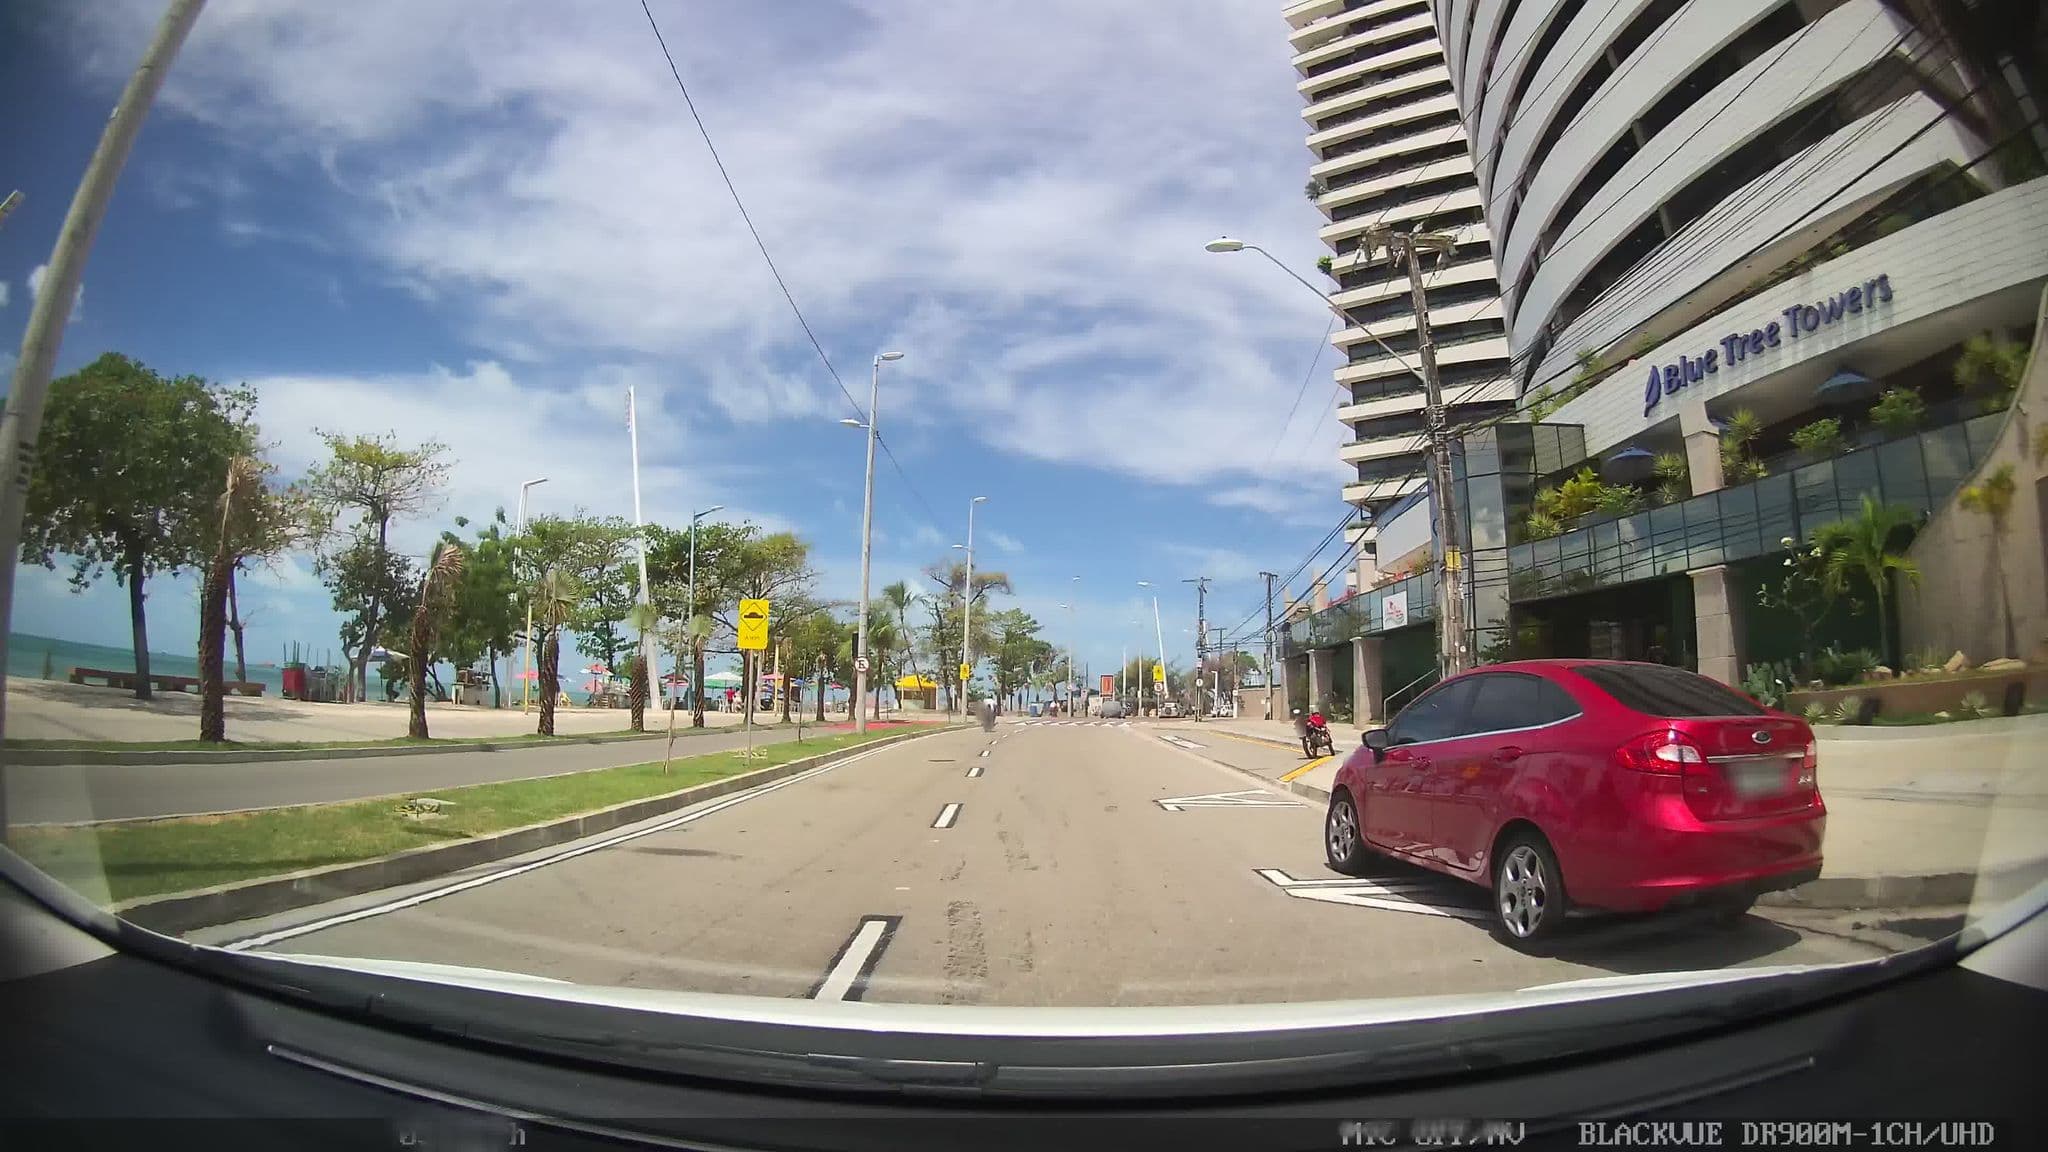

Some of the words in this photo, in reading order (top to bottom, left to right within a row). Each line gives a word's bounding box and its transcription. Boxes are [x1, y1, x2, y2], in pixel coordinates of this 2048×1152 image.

[1663, 349, 1719, 395] Blue
[1720, 321, 1781, 366] Tree
[1782, 273, 1893, 338] Towers
